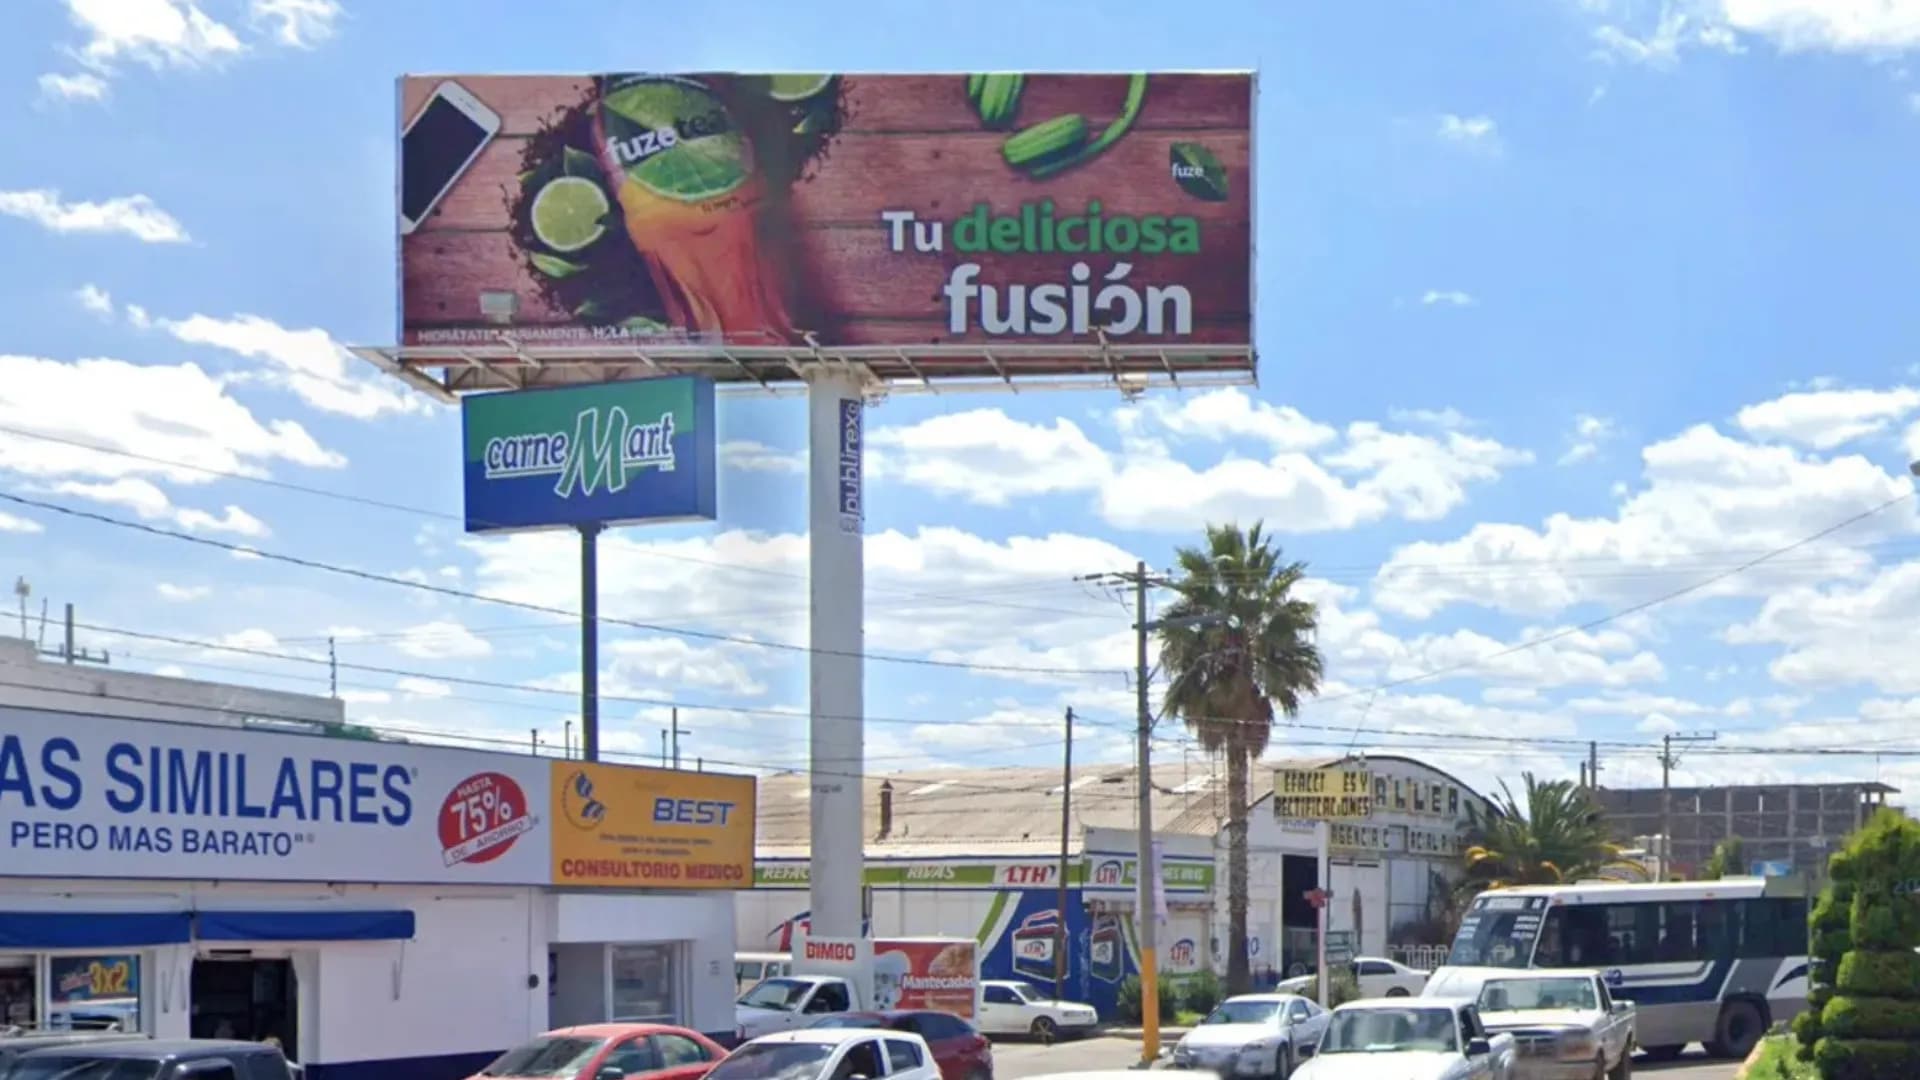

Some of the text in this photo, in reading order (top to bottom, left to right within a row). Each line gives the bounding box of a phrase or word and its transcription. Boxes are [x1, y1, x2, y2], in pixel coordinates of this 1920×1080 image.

[882, 200, 1201, 254] Tu deliciosa
[944, 262, 1193, 336] fusión
[105, 742, 413, 826] SIMILARES
[456, 776, 493, 798] HASTA
[1375, 776, 1459, 814] ALLER
[450, 785, 512, 840] 75%
[653, 797, 736, 825] BEST
[11, 821, 99, 849] PERO
[109, 826, 173, 853] MAS
[182, 829, 292, 856] BARATO
[561, 858, 744, 881] CONSULTORIO MEDICO
[762, 866, 810, 880] REFAC
[1005, 865, 1050, 884] LTH
